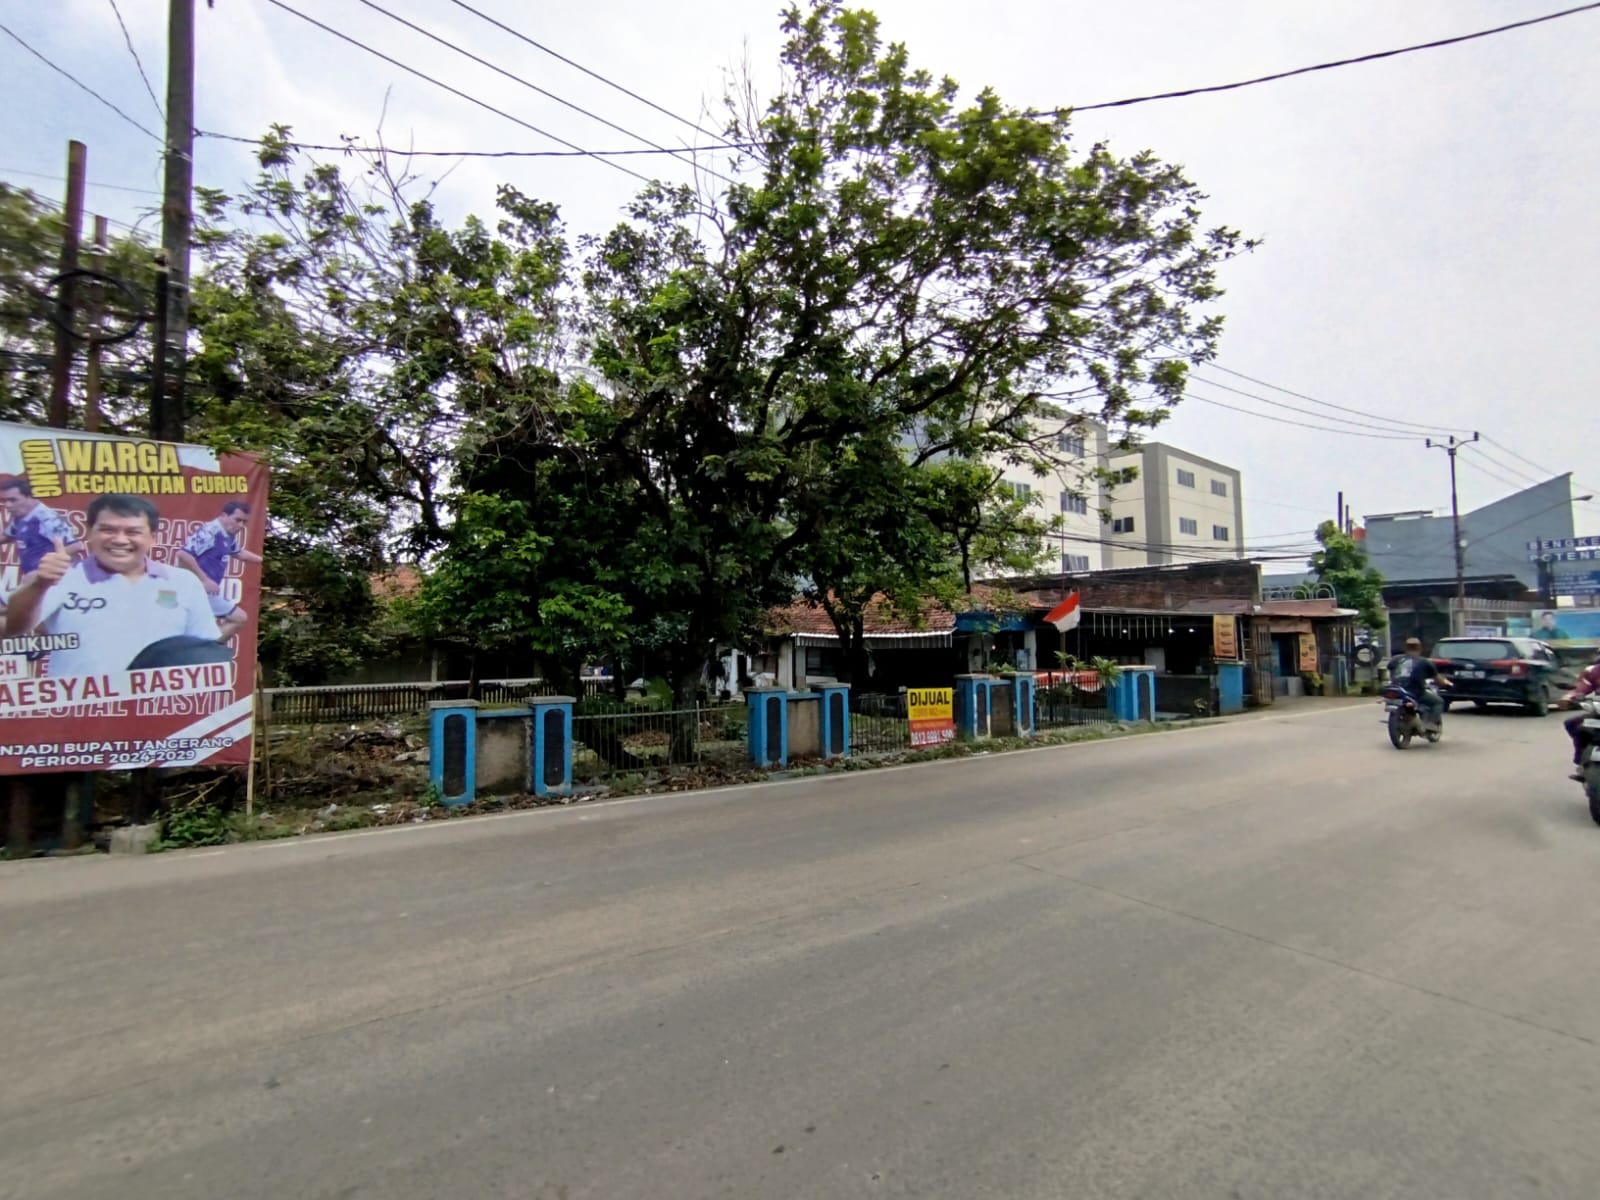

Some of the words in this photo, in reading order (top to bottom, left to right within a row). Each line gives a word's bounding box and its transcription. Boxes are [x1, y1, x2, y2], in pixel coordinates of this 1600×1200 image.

[58, 440, 181, 474] WARGA
[65, 474, 186, 494] KECAMATAN
[192, 475, 248, 493] CURUG
[130, 665, 227, 694] RASYID
[910, 691, 950, 706] DIJUAL
[65, 741, 129, 753] BUPATI
[134, 737, 233, 751] TANGERANG
[21, 753, 104, 767] PERIODE
[109, 750, 195, 765] 2024-2029
